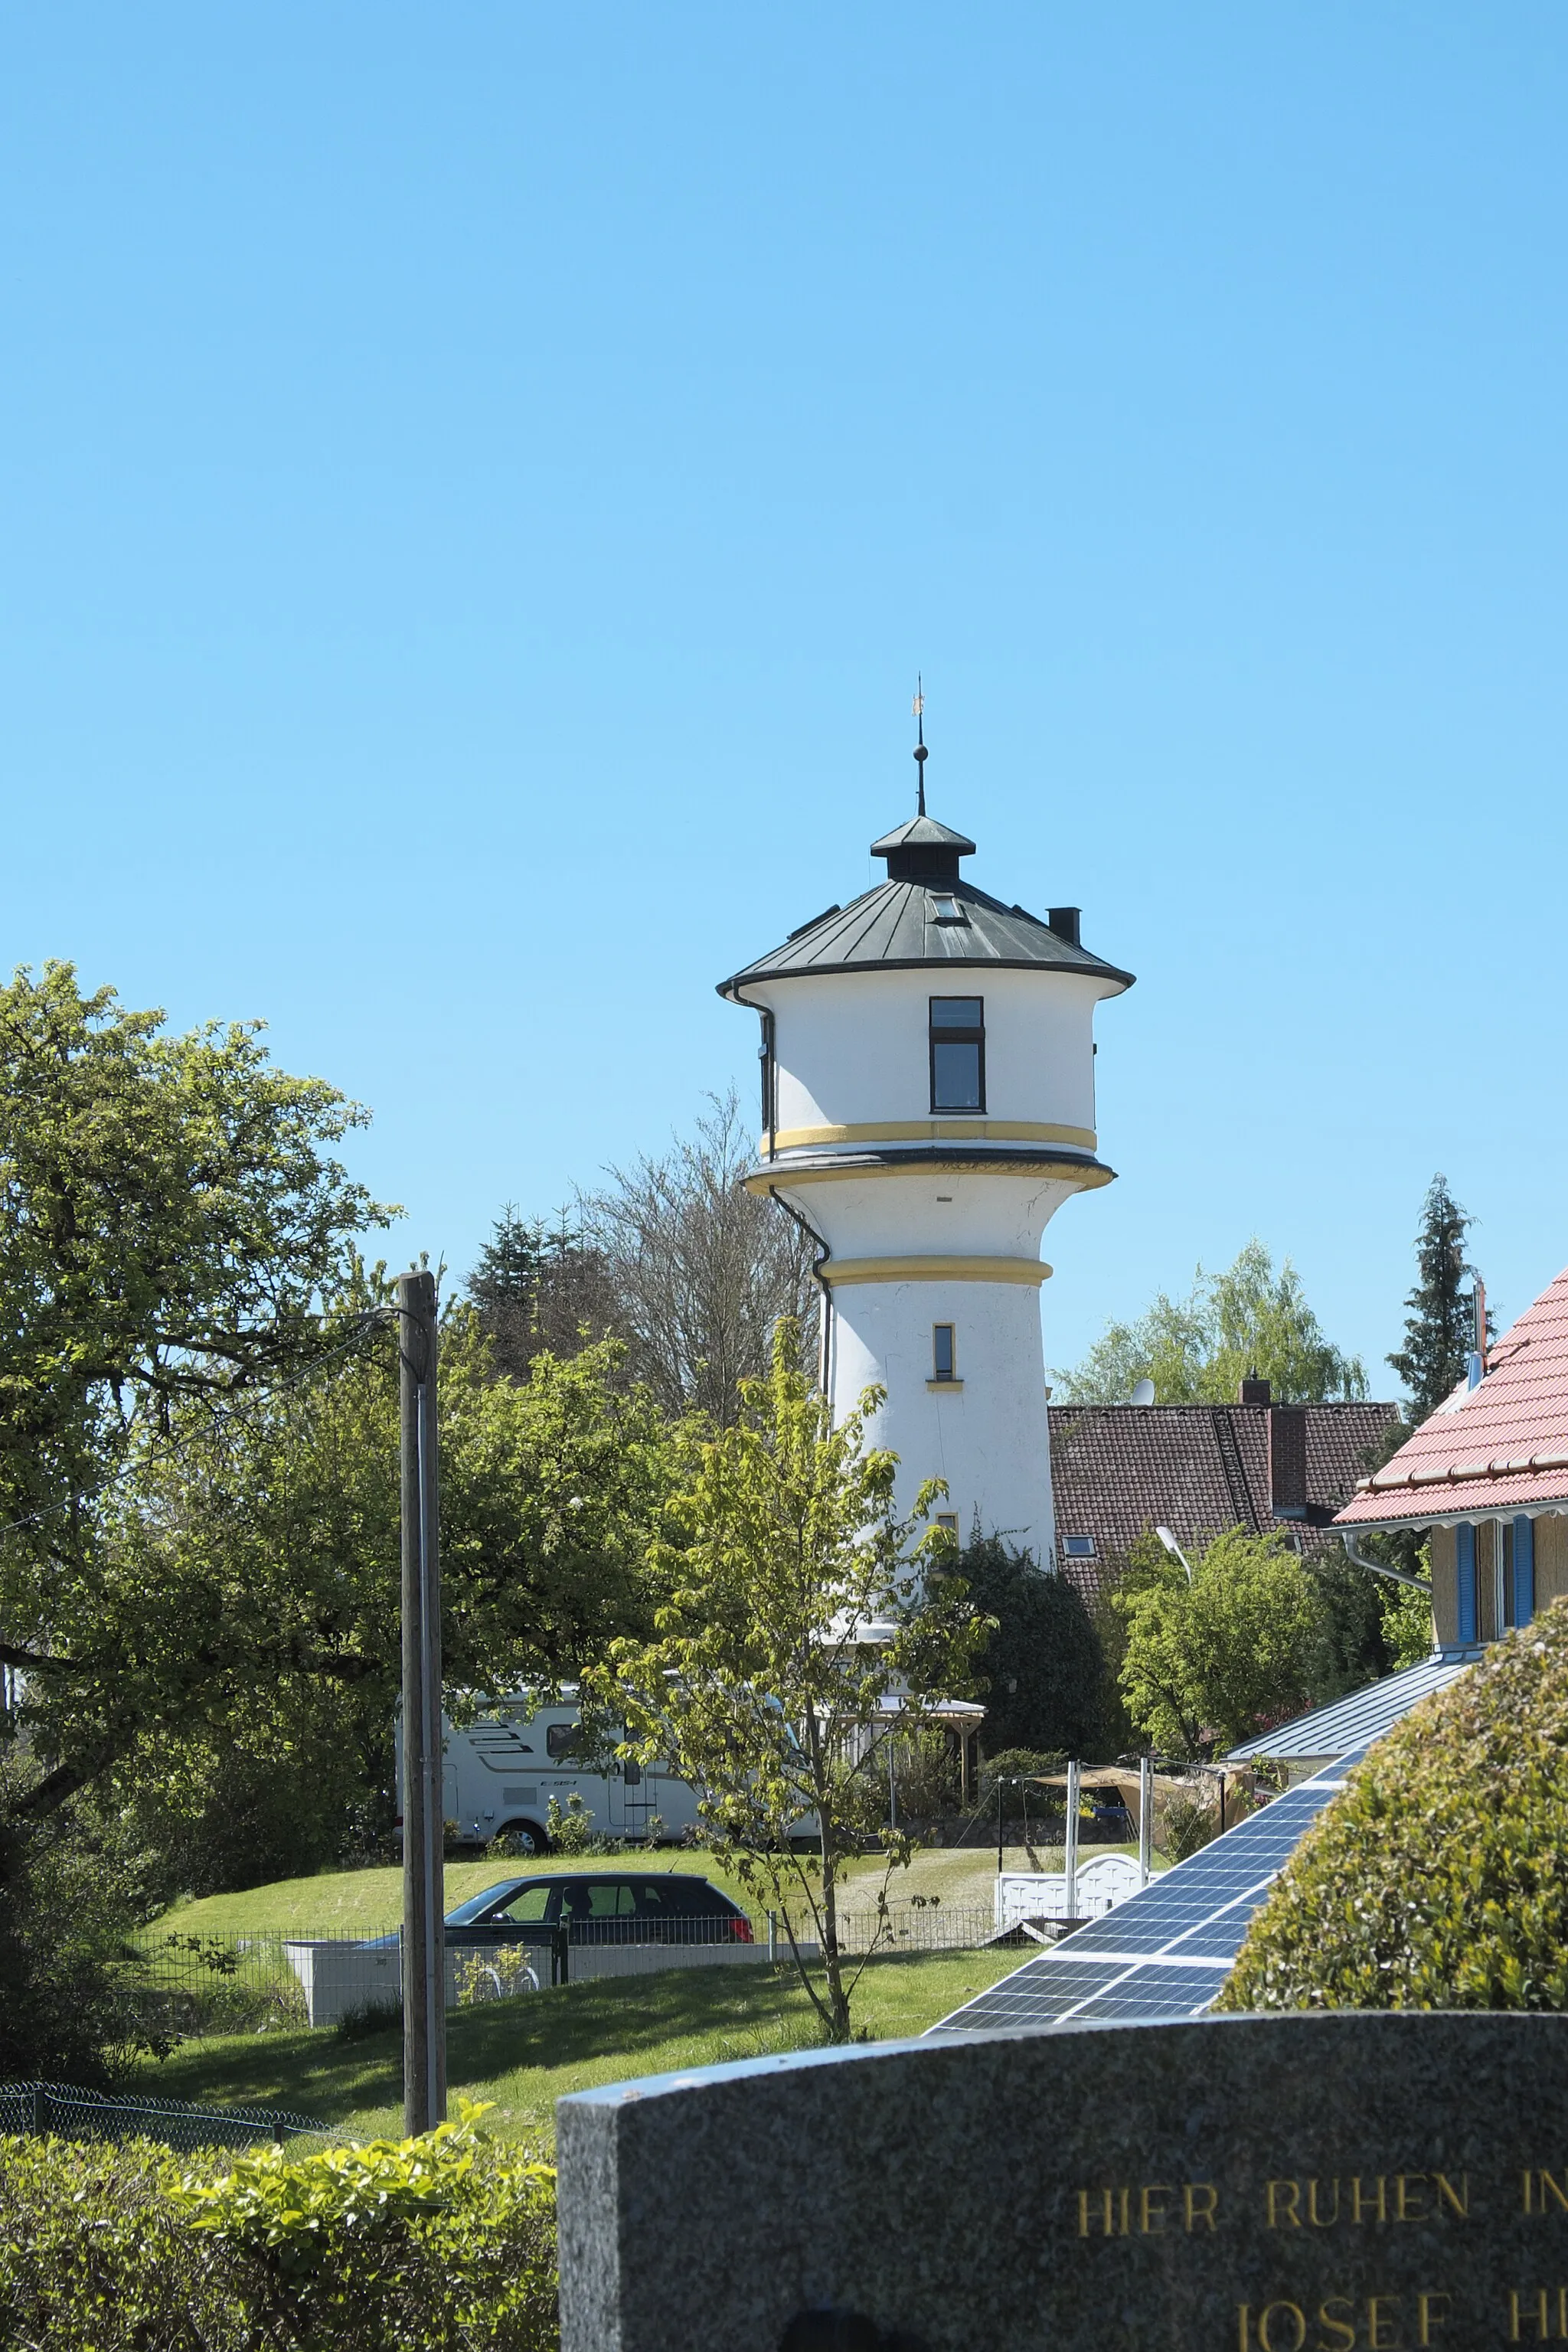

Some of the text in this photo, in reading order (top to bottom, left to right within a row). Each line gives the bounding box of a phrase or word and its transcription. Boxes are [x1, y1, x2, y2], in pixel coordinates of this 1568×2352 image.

[1078, 2168, 1568, 2237] HIER RUHEN IN
